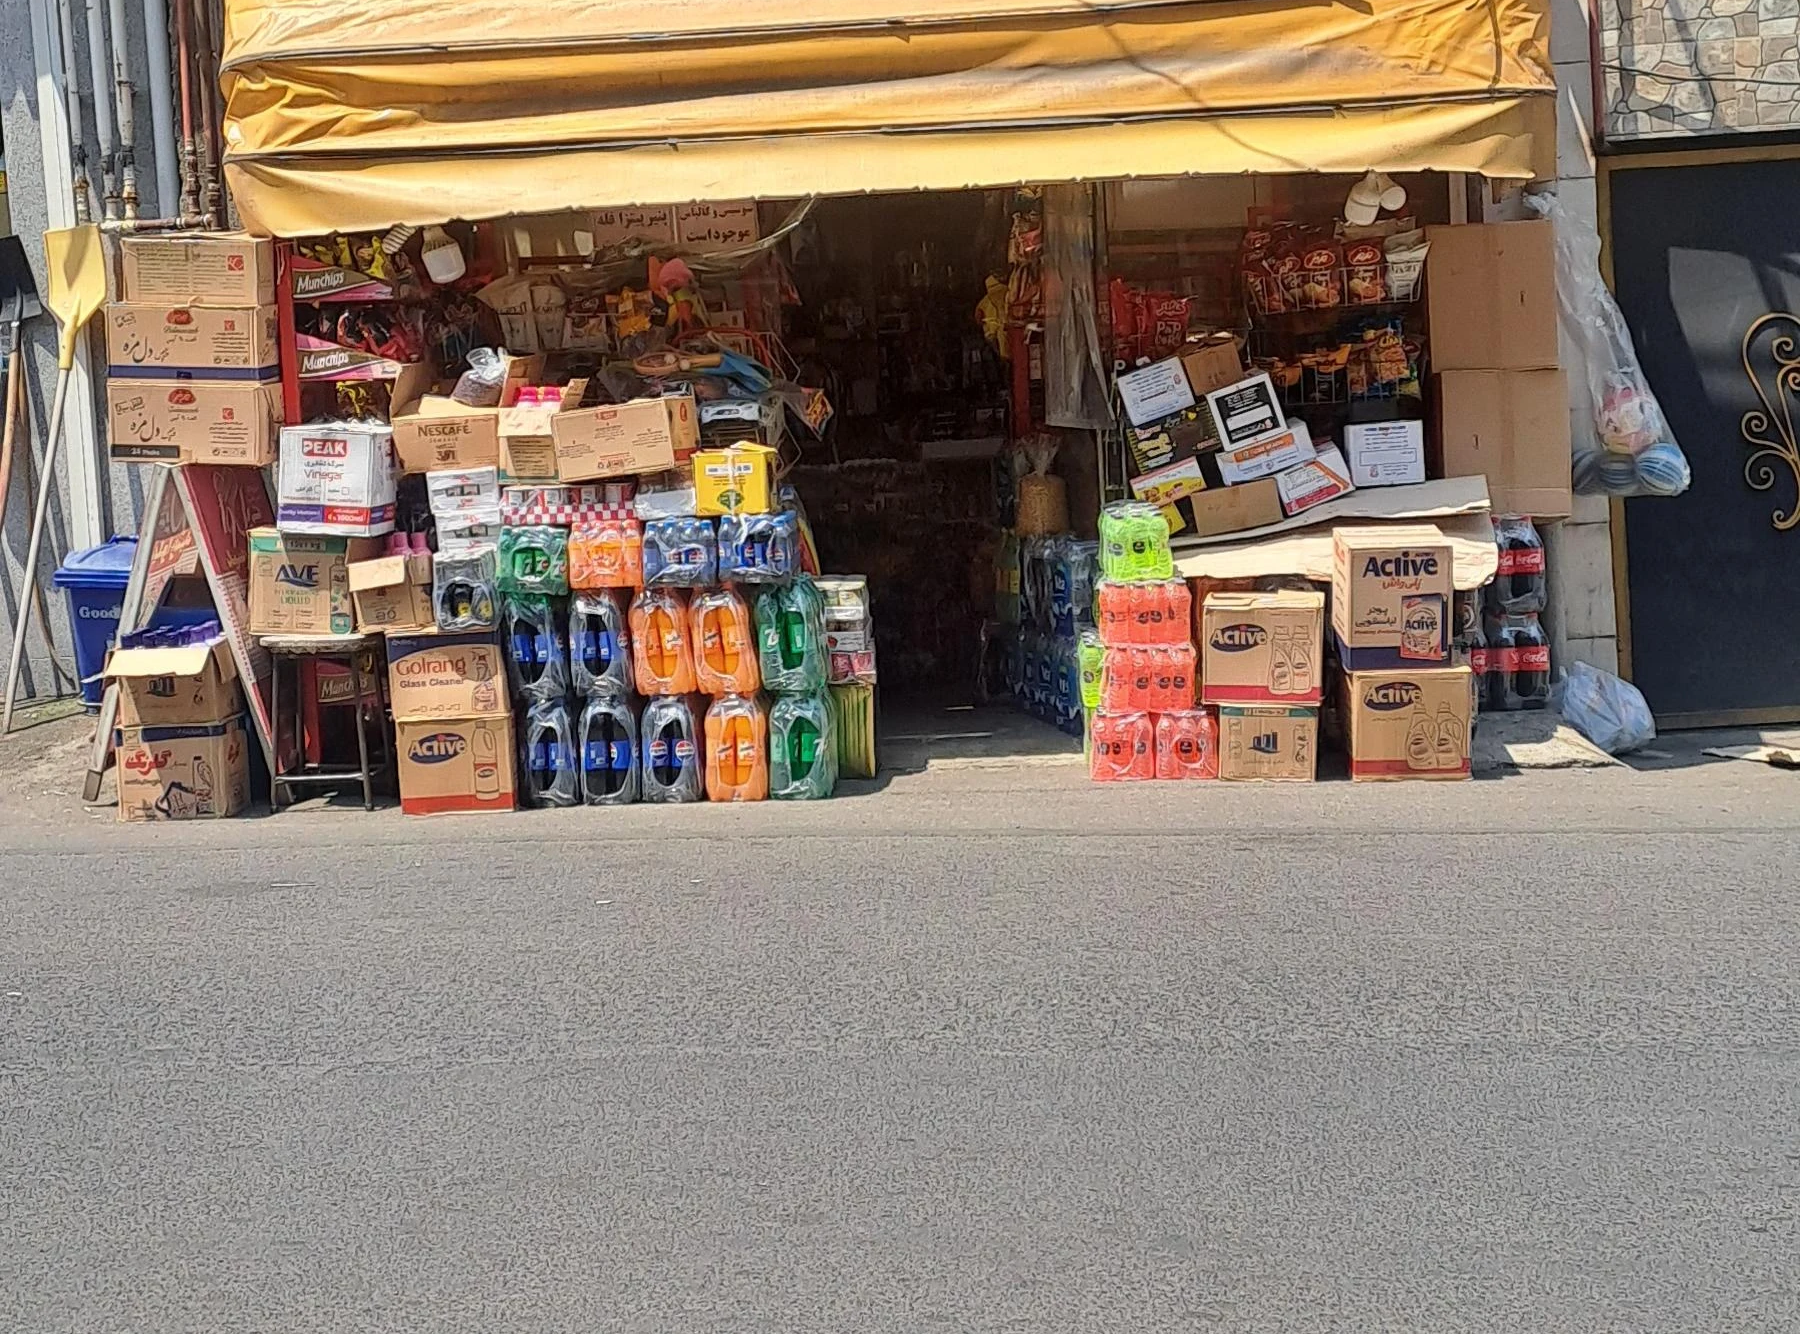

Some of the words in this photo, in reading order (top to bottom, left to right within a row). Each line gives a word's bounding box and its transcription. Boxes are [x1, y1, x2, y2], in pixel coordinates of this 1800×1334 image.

[686, 228, 712, 243] است
[297, 272, 344, 293] Munchips
[302, 349, 349, 372] Munchips
[303, 440, 346, 456] PEAK
[304, 469, 345, 481] Vinegar
[1363, 551, 1438, 579] Active
[1405, 616, 1438, 630] Active
[1210, 624, 1267, 645] Active
[396, 657, 467, 676] Golrang
[1365, 683, 1421, 703] Active
[408, 733, 467, 757] Active
[125, 750, 172, 776] گلرنگ
